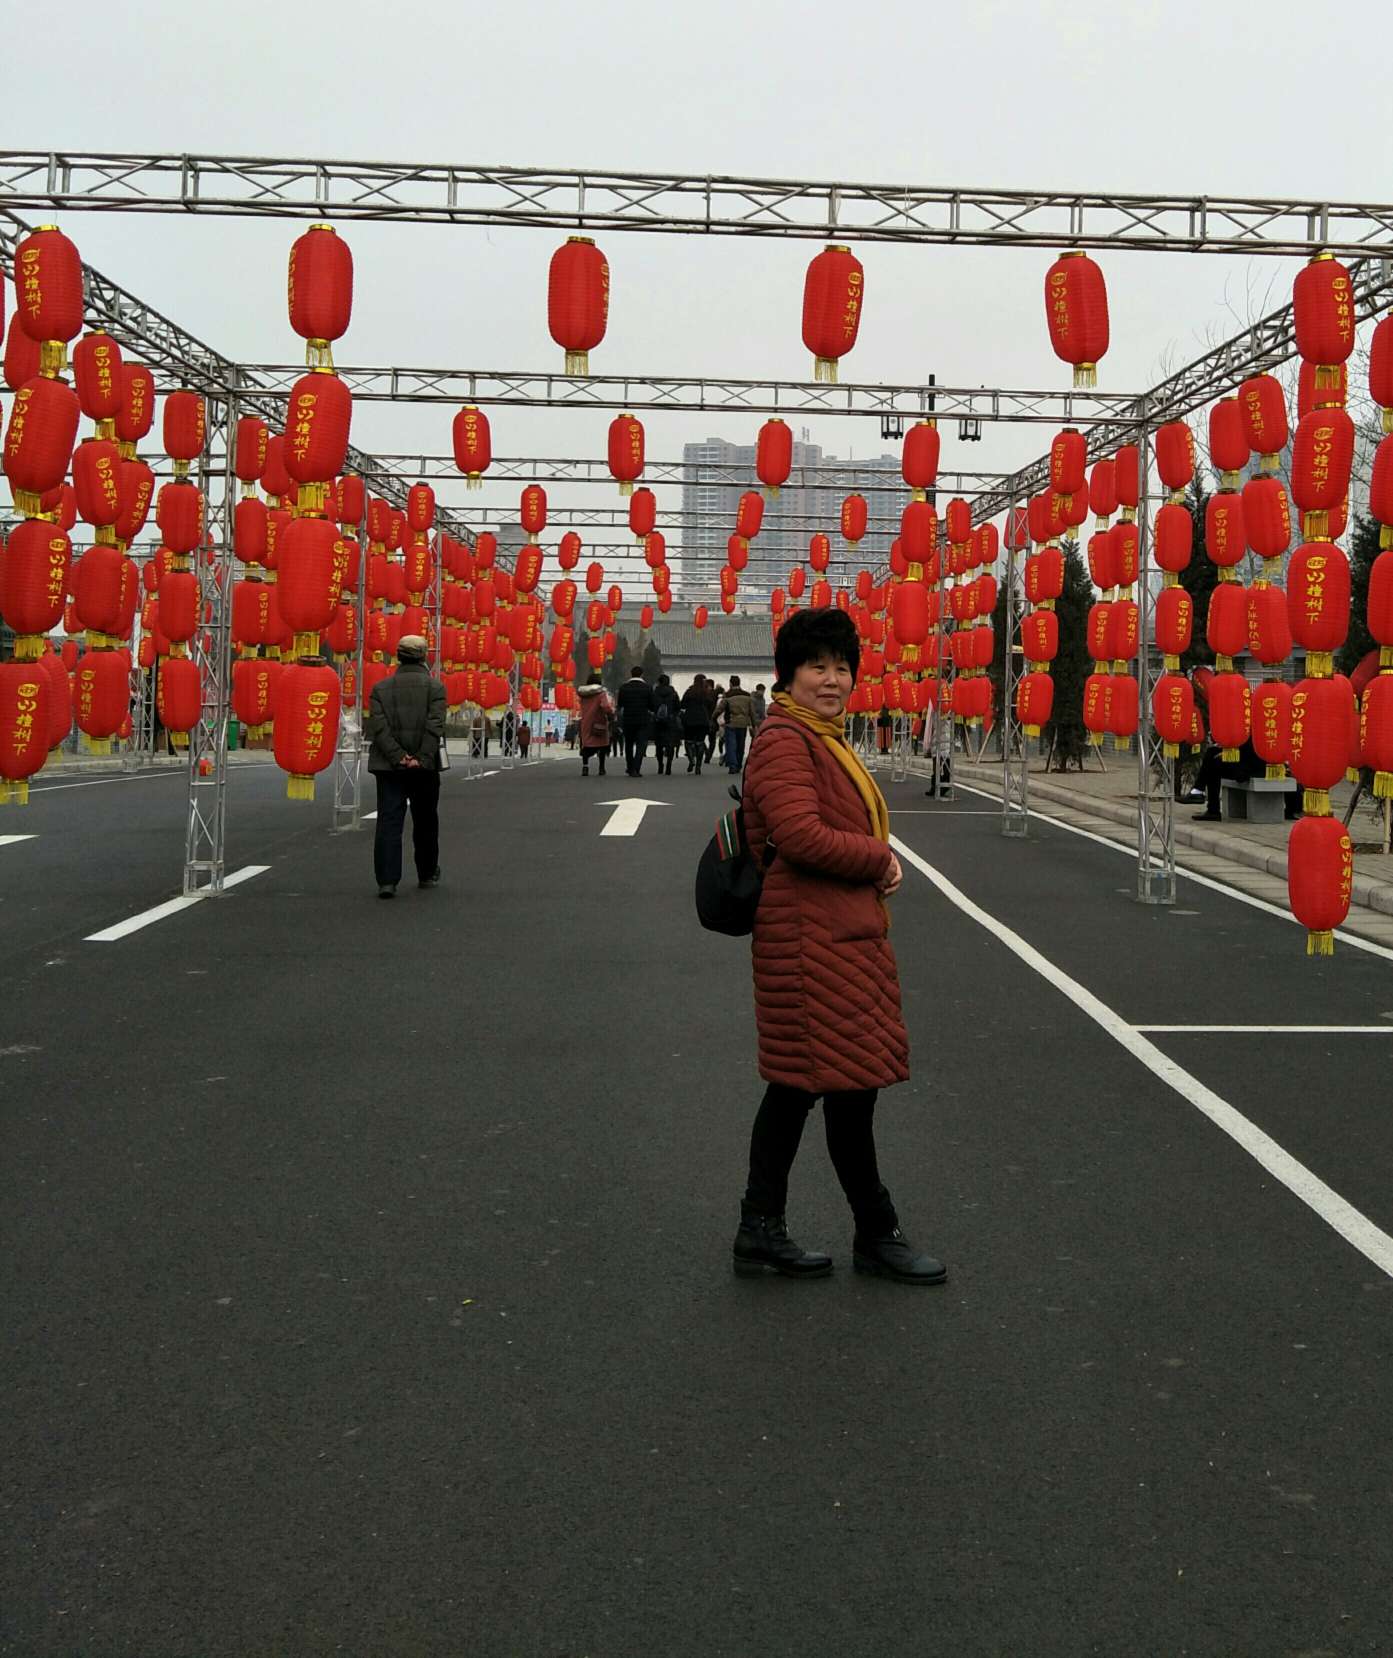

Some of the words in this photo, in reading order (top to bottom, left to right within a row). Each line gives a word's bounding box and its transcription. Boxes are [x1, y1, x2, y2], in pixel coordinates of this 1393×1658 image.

[22, 264, 42, 320] 山楂树下
[1335, 291, 1350, 343] 山楂树下
[9, 403, 29, 457] 山楂树下
[294, 409, 315, 463] 山楂树下
[1311, 442, 1332, 492] 山楂树下
[48, 554, 66, 609] 山楂树下
[1304, 571, 1325, 625] 山楂树下
[13, 700, 37, 756] 山楂树下
[304, 708, 327, 761] 山楂树下
[1263, 710, 1278, 750] 山楂树下
[1290, 708, 1305, 761] 山楂树下
